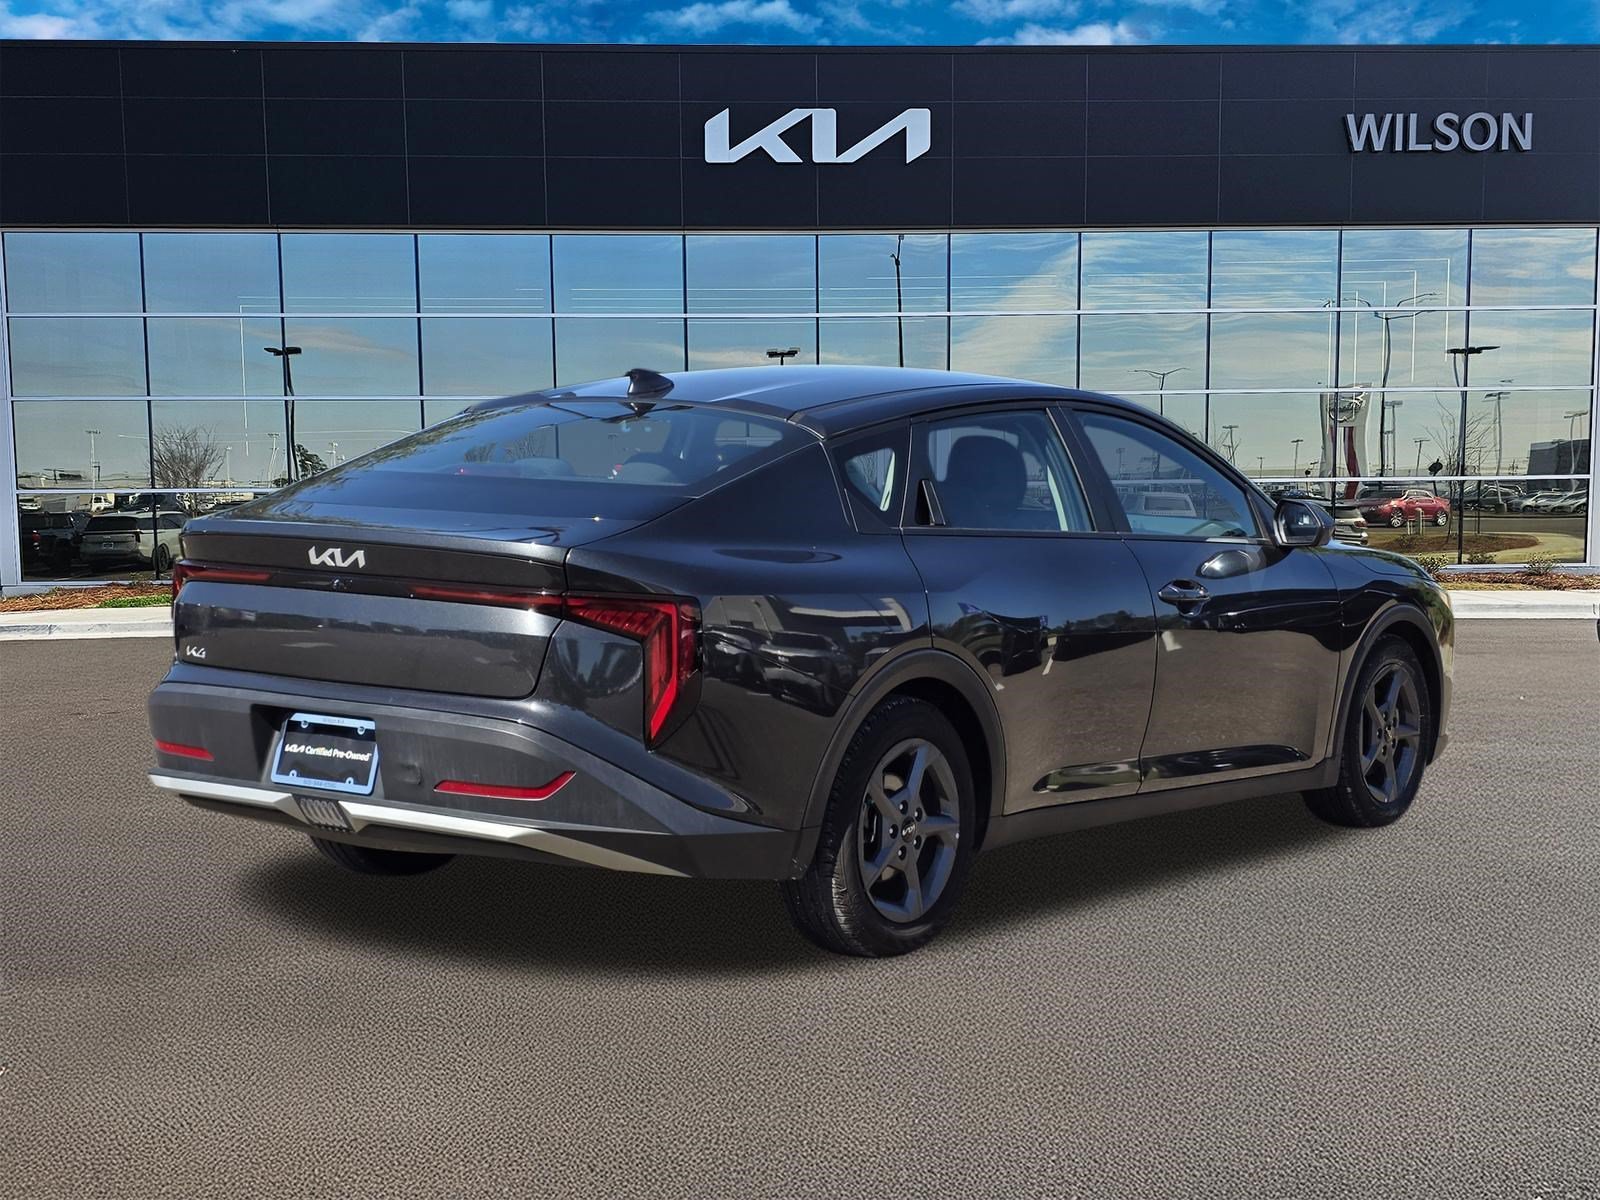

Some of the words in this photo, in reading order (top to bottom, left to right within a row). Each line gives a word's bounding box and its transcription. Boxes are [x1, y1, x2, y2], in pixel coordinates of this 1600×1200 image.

[704, 107, 931, 164] KIA
[1345, 111, 1534, 152] WILSON
[308, 545, 366, 569] KIA
[305, 745, 333, 757] Certified
